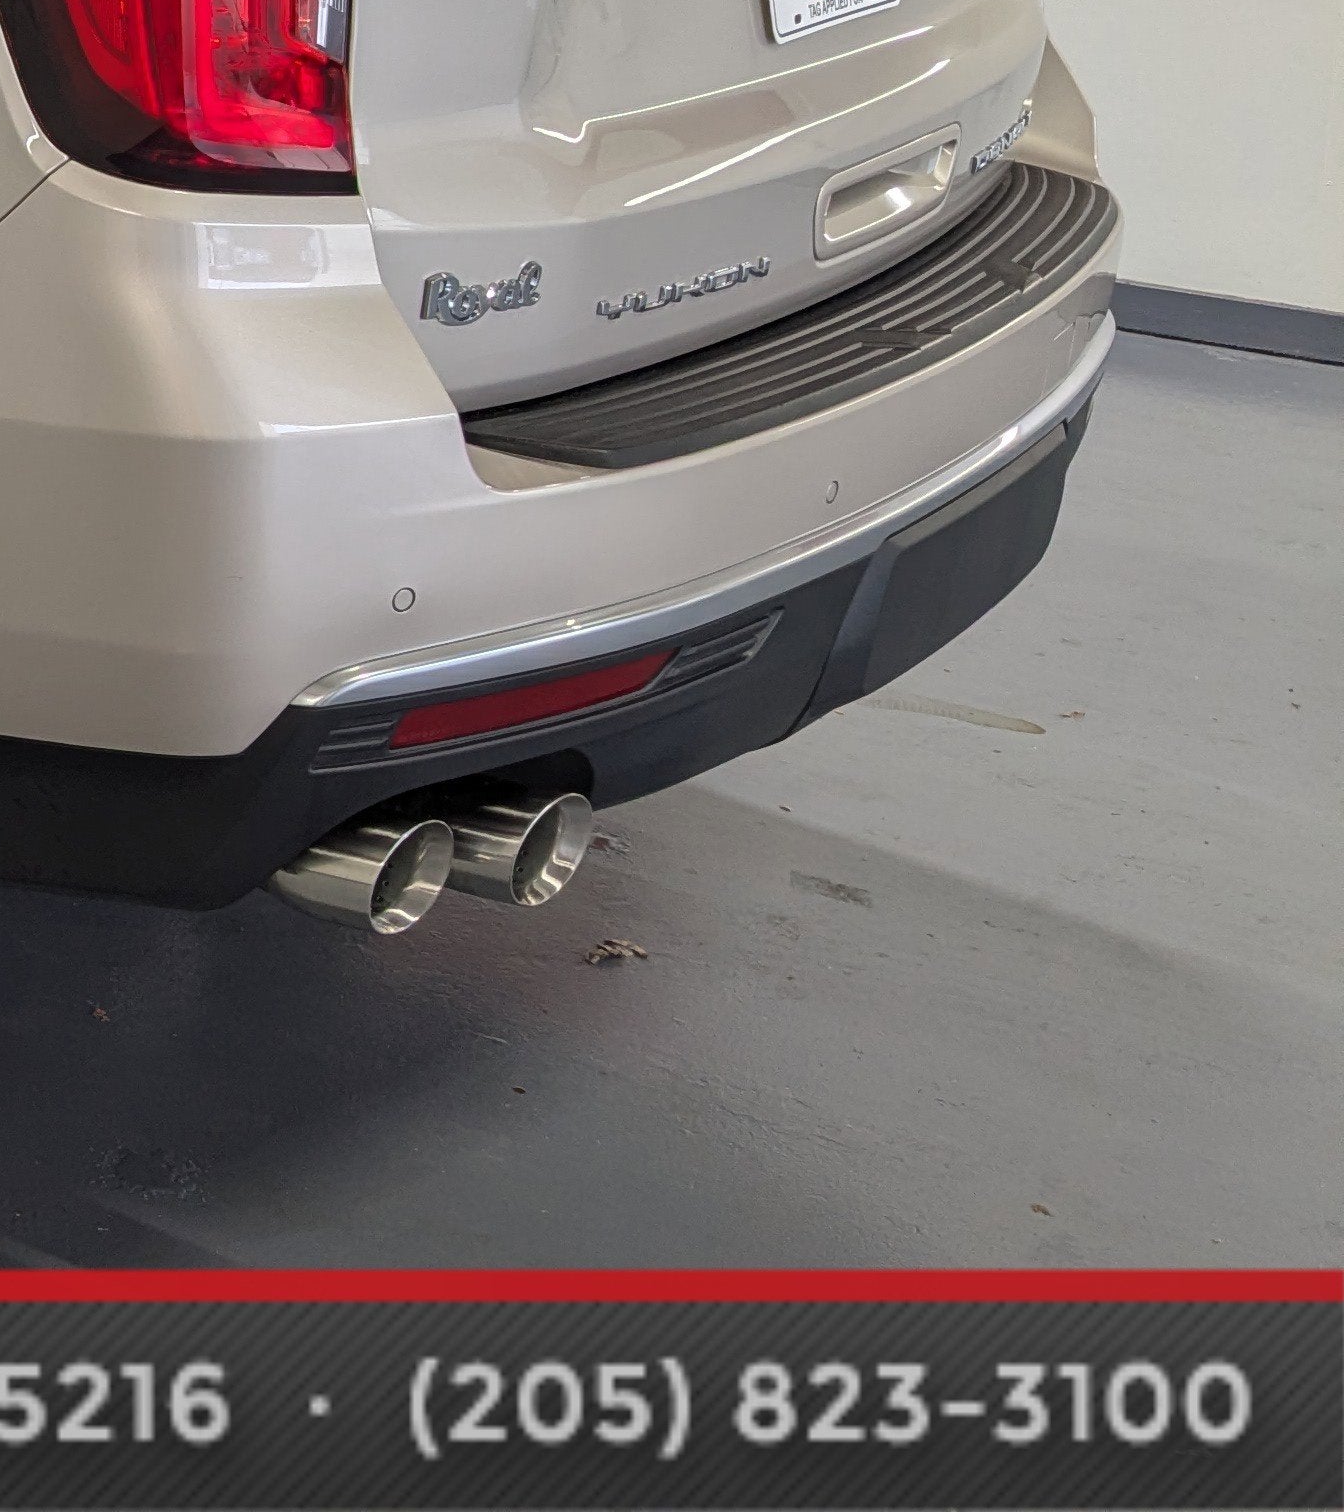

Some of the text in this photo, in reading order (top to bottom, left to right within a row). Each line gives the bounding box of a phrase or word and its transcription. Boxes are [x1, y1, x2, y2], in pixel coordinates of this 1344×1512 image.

[808, 1, 822, 18] TAG
[420, 260, 543, 327] Royal
[595, 256, 771, 320] YUKON
